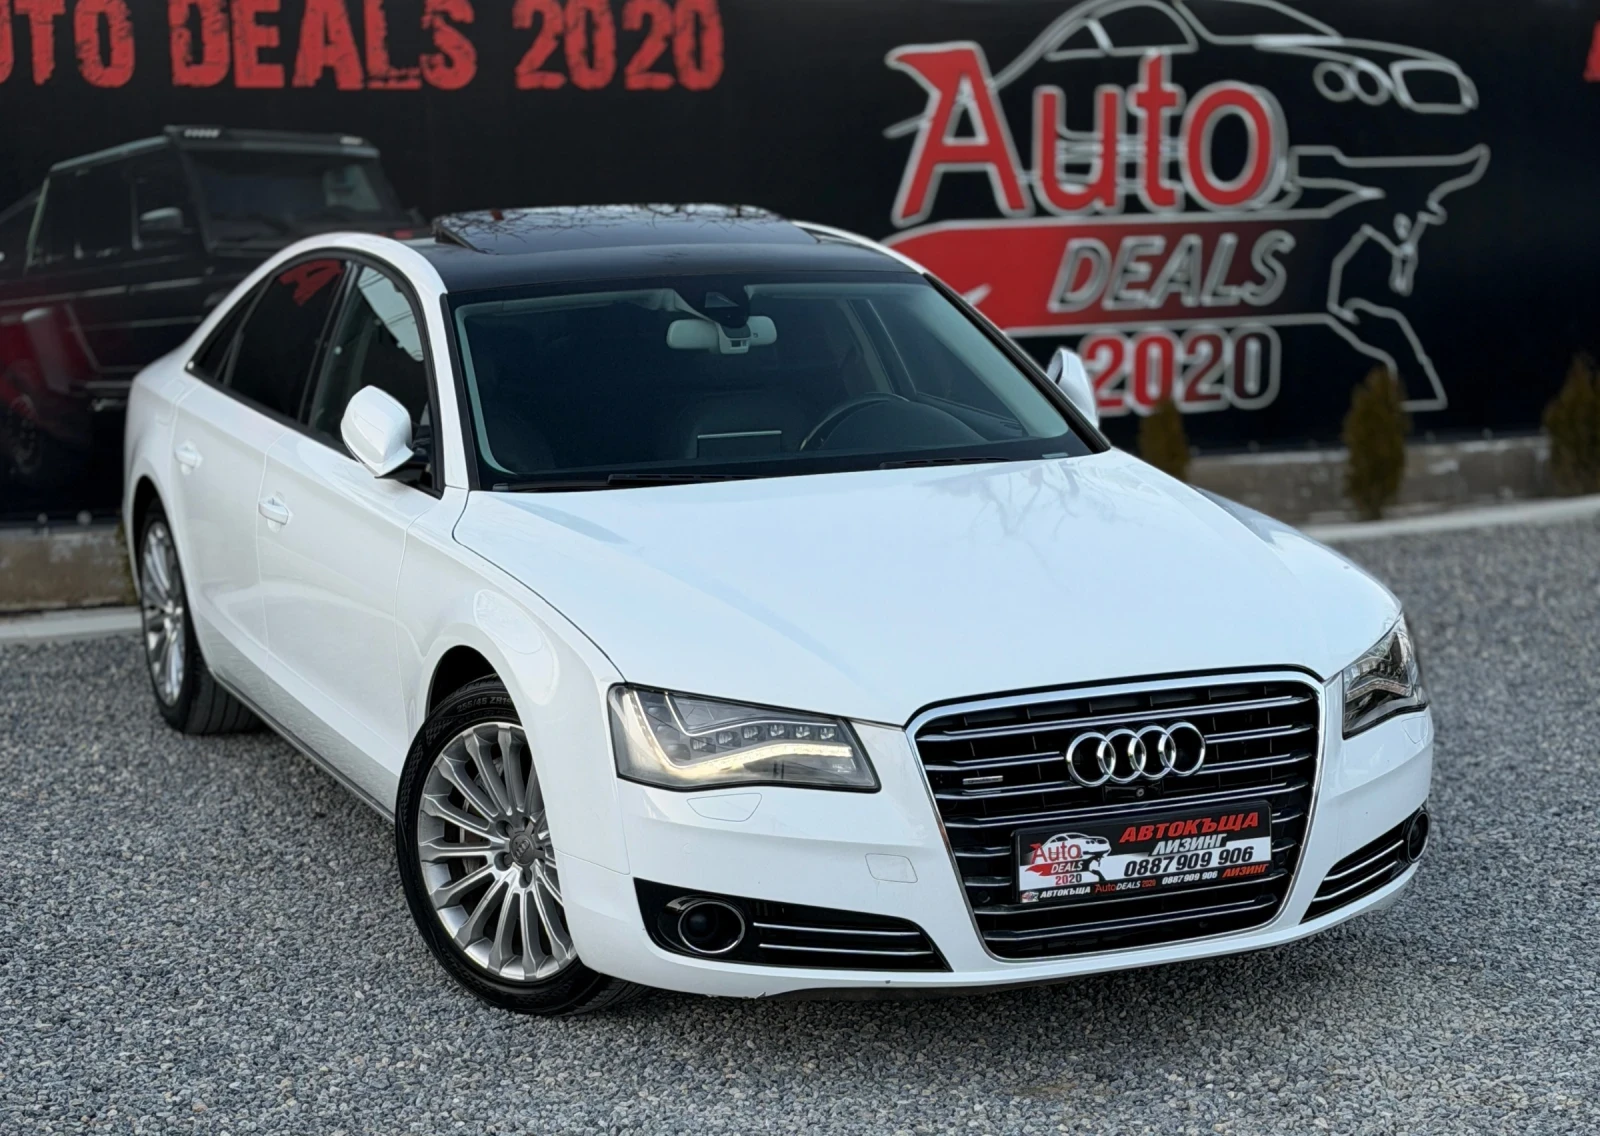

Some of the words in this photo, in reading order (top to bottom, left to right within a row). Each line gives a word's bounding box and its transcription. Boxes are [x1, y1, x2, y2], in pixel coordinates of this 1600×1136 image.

[0, 0, 136, 88] TO
[170, 0, 477, 90] DEALS
[513, 0, 724, 90] 2020
[886, 41, 1286, 226] Auto
[1048, 229, 1295, 313] DEALS
[1078, 325, 1281, 416] 2020
[1120, 813, 1258, 842] АВТОКЪЩА
[1029, 841, 1082, 865] Auto
[1151, 833, 1227, 856] ЛИЗИНГ
[1050, 861, 1083, 874] DEALS
[1123, 856, 1175, 877] 0887
[1175, 851, 1213, 871] 909
[1217, 846, 1254, 865] 906
[1040, 885, 1091, 899] АВТОКЪЩА
[1161, 874, 1184, 885] 0887
[1183, 872, 1200, 882] 909
[1201, 870, 1218, 879] 906
[1222, 863, 1269, 878] ЛИЗИНГ
[1055, 873, 1082, 886] 2020
